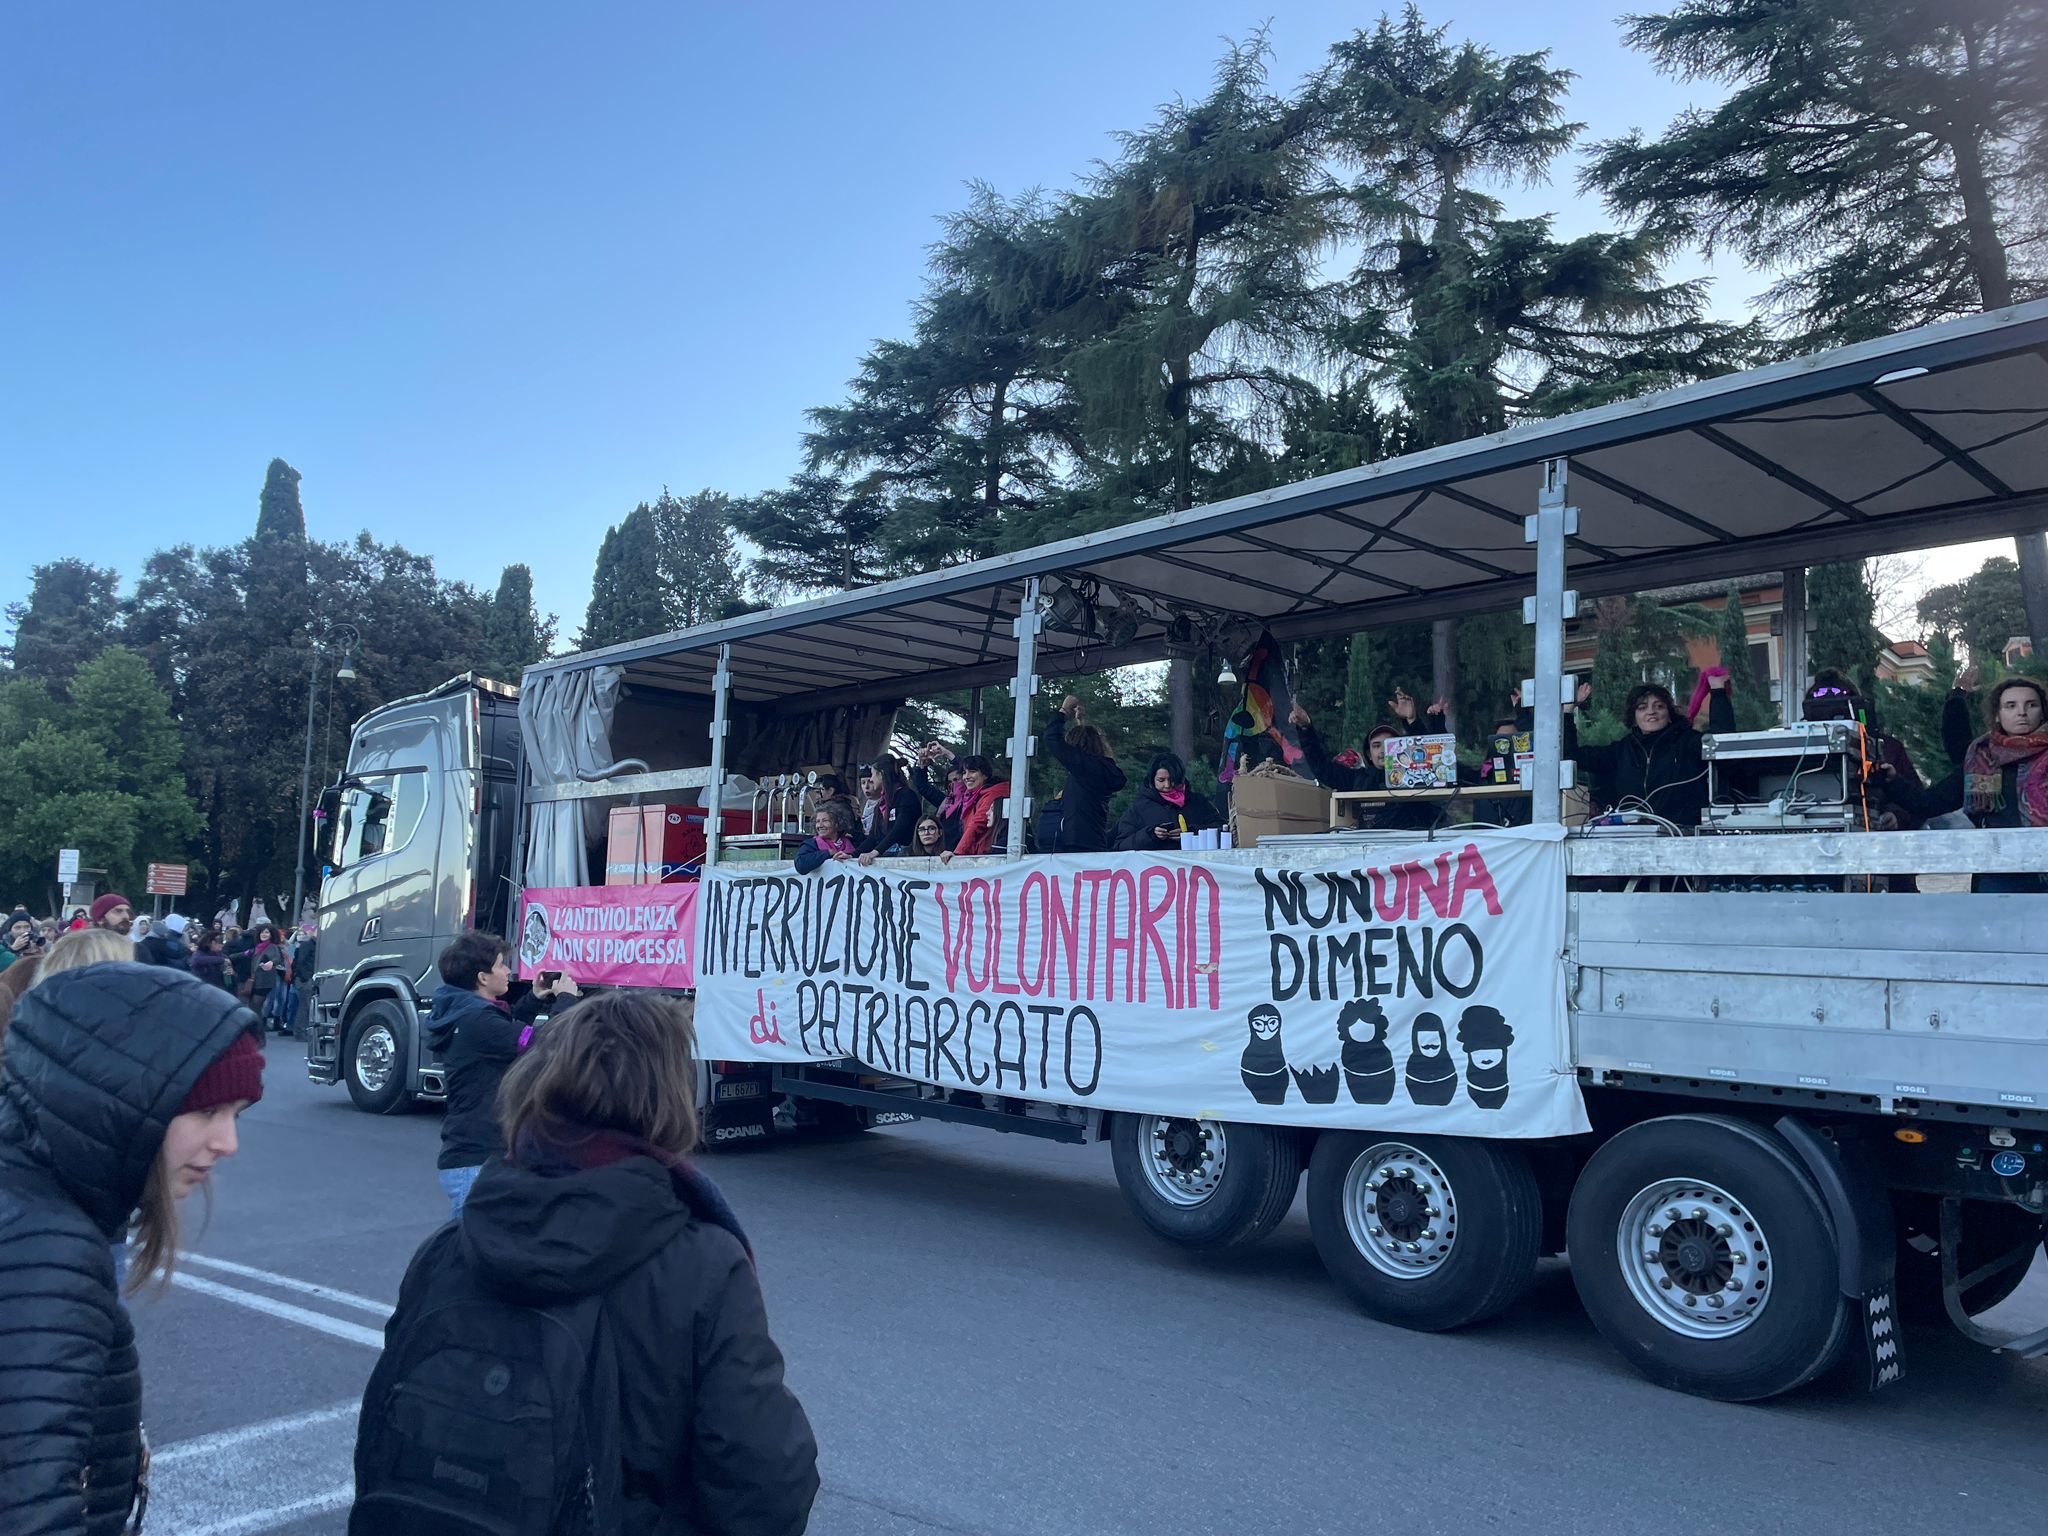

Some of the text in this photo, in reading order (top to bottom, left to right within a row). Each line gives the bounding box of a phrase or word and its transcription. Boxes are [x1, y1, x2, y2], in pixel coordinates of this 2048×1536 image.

[553, 905, 678, 932] L'ANTIVIOLENZA
[702, 874, 930, 991] INTERRUZIONE
[935, 865, 1221, 1010] VOLONTARIA
[552, 938, 687, 965] NON SI PROCESSA
[750, 979, 1103, 1096] di PATRIARCATO
[715, 1124, 766, 1140] SCANIA
